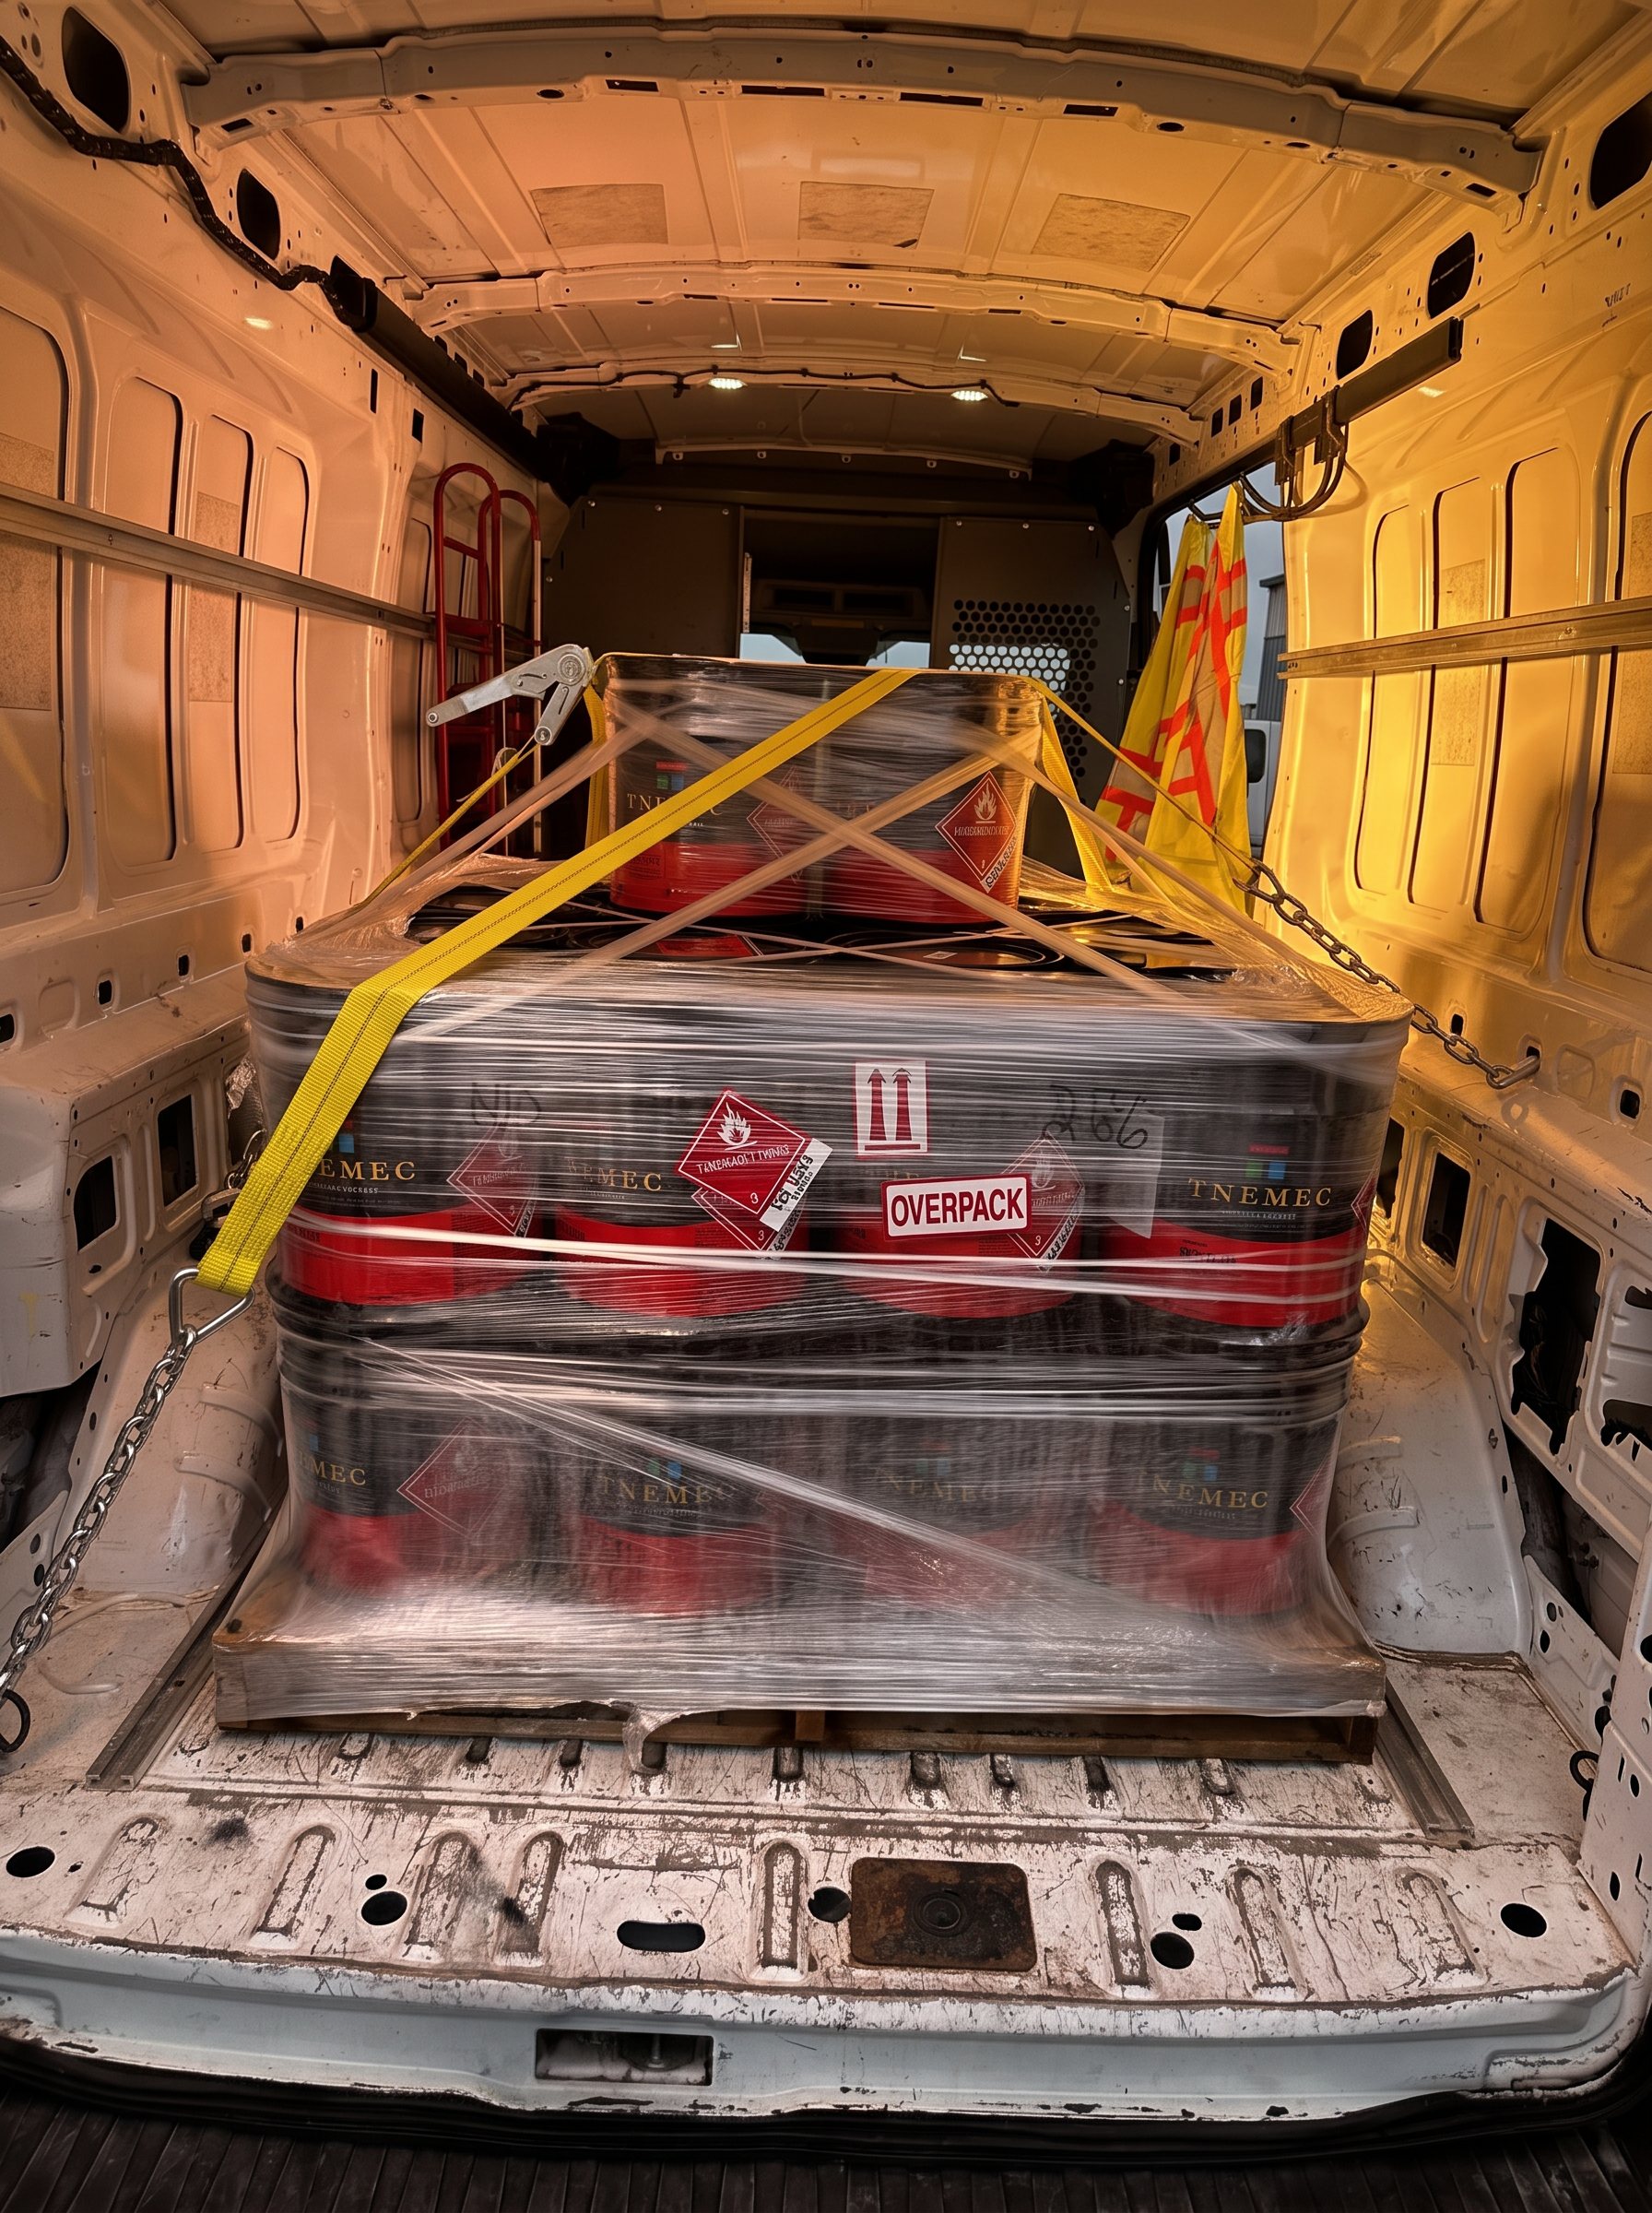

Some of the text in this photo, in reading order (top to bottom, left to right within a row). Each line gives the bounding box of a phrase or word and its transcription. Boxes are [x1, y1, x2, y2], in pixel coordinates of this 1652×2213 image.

[315, 1158, 415, 1180] EMEC
[750, 1192, 759, 1204] 3
[1188, 1178, 1332, 1207] TNEMEC
[891, 1188, 1024, 1227] OVERPACK
[758, 1230, 764, 1241] 3
